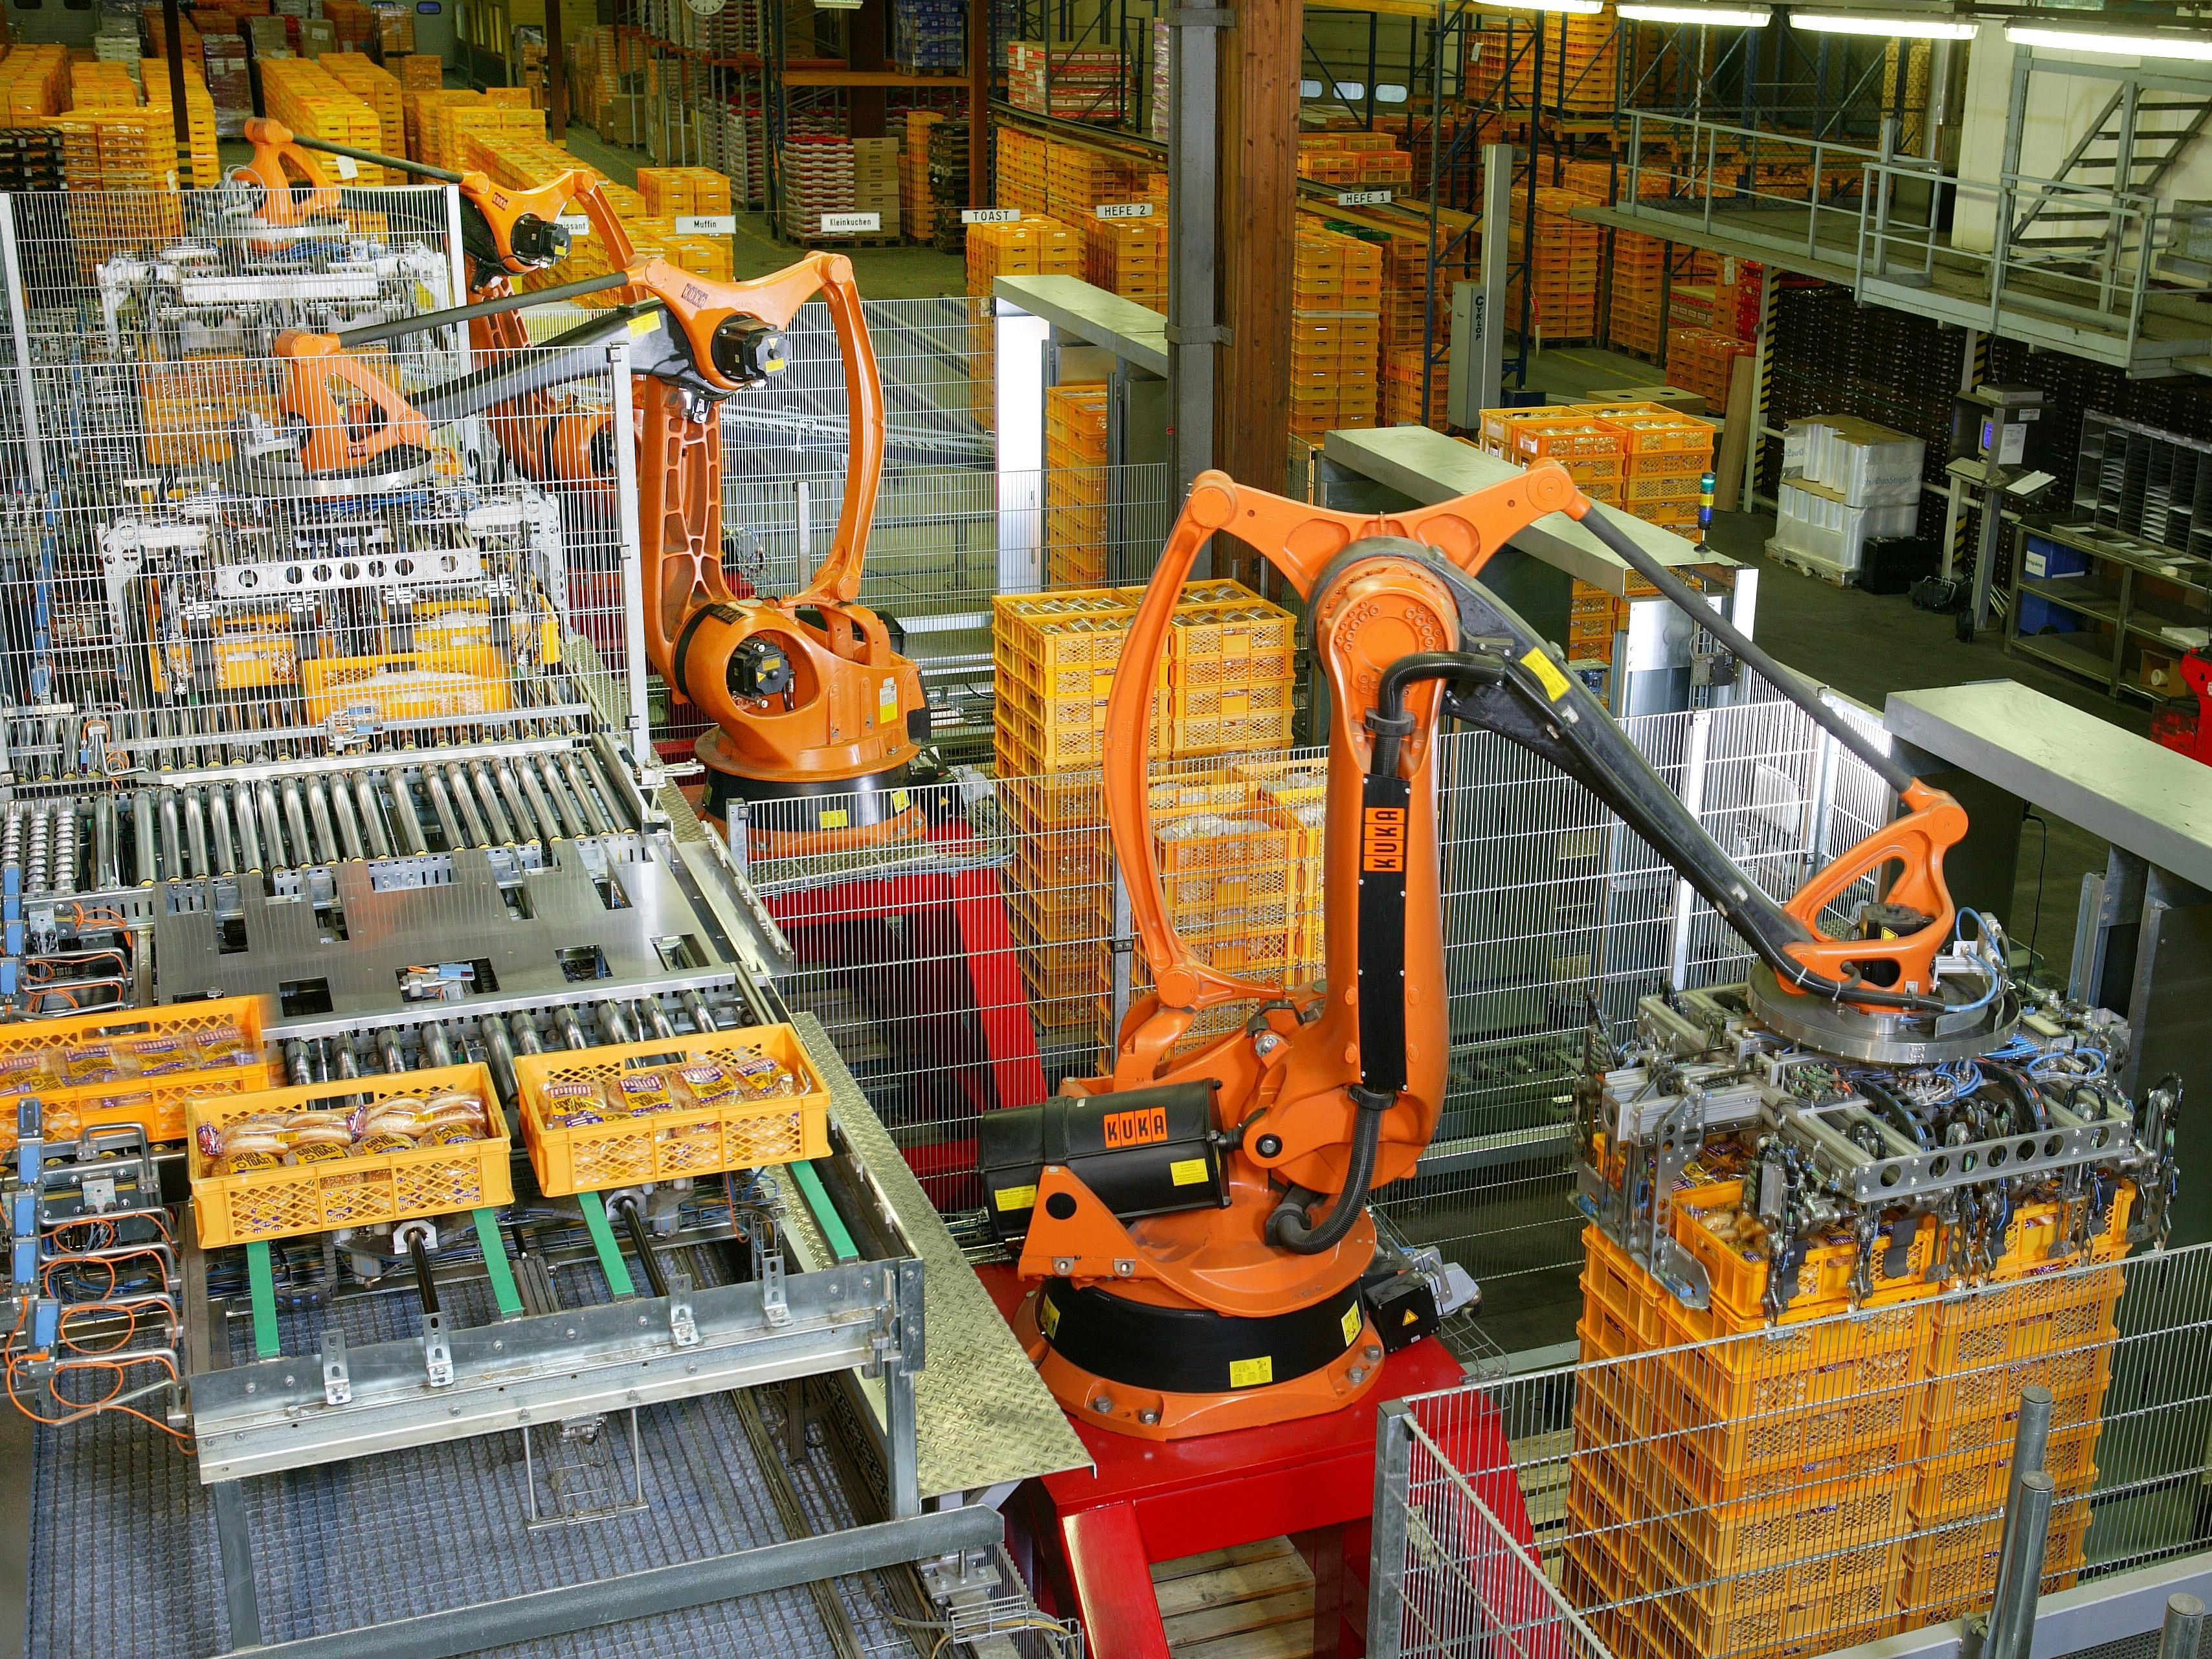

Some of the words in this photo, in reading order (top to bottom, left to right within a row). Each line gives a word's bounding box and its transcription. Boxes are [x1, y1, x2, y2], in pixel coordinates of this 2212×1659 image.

[1346, 193, 1372, 203] HEFE
[1380, 192, 1385, 201] 1
[973, 210, 1009, 221] TOAST
[1104, 206, 1133, 216] HEFE
[1140, 205, 1145, 214] 2
[562, 221, 586, 230] issant
[829, 217, 871, 226] Kleinkuchen
[682, 284, 708, 308] KUKA
[1475, 295, 1484, 340] CYKLOP
[1374, 810, 1398, 868] KUKA
[1107, 1115, 1165, 1141] KUKA
[296, 1143, 328, 1156] GOLDEN
[313, 1146, 340, 1158] TOAST
[246, 1156, 273, 1168] TOAST
